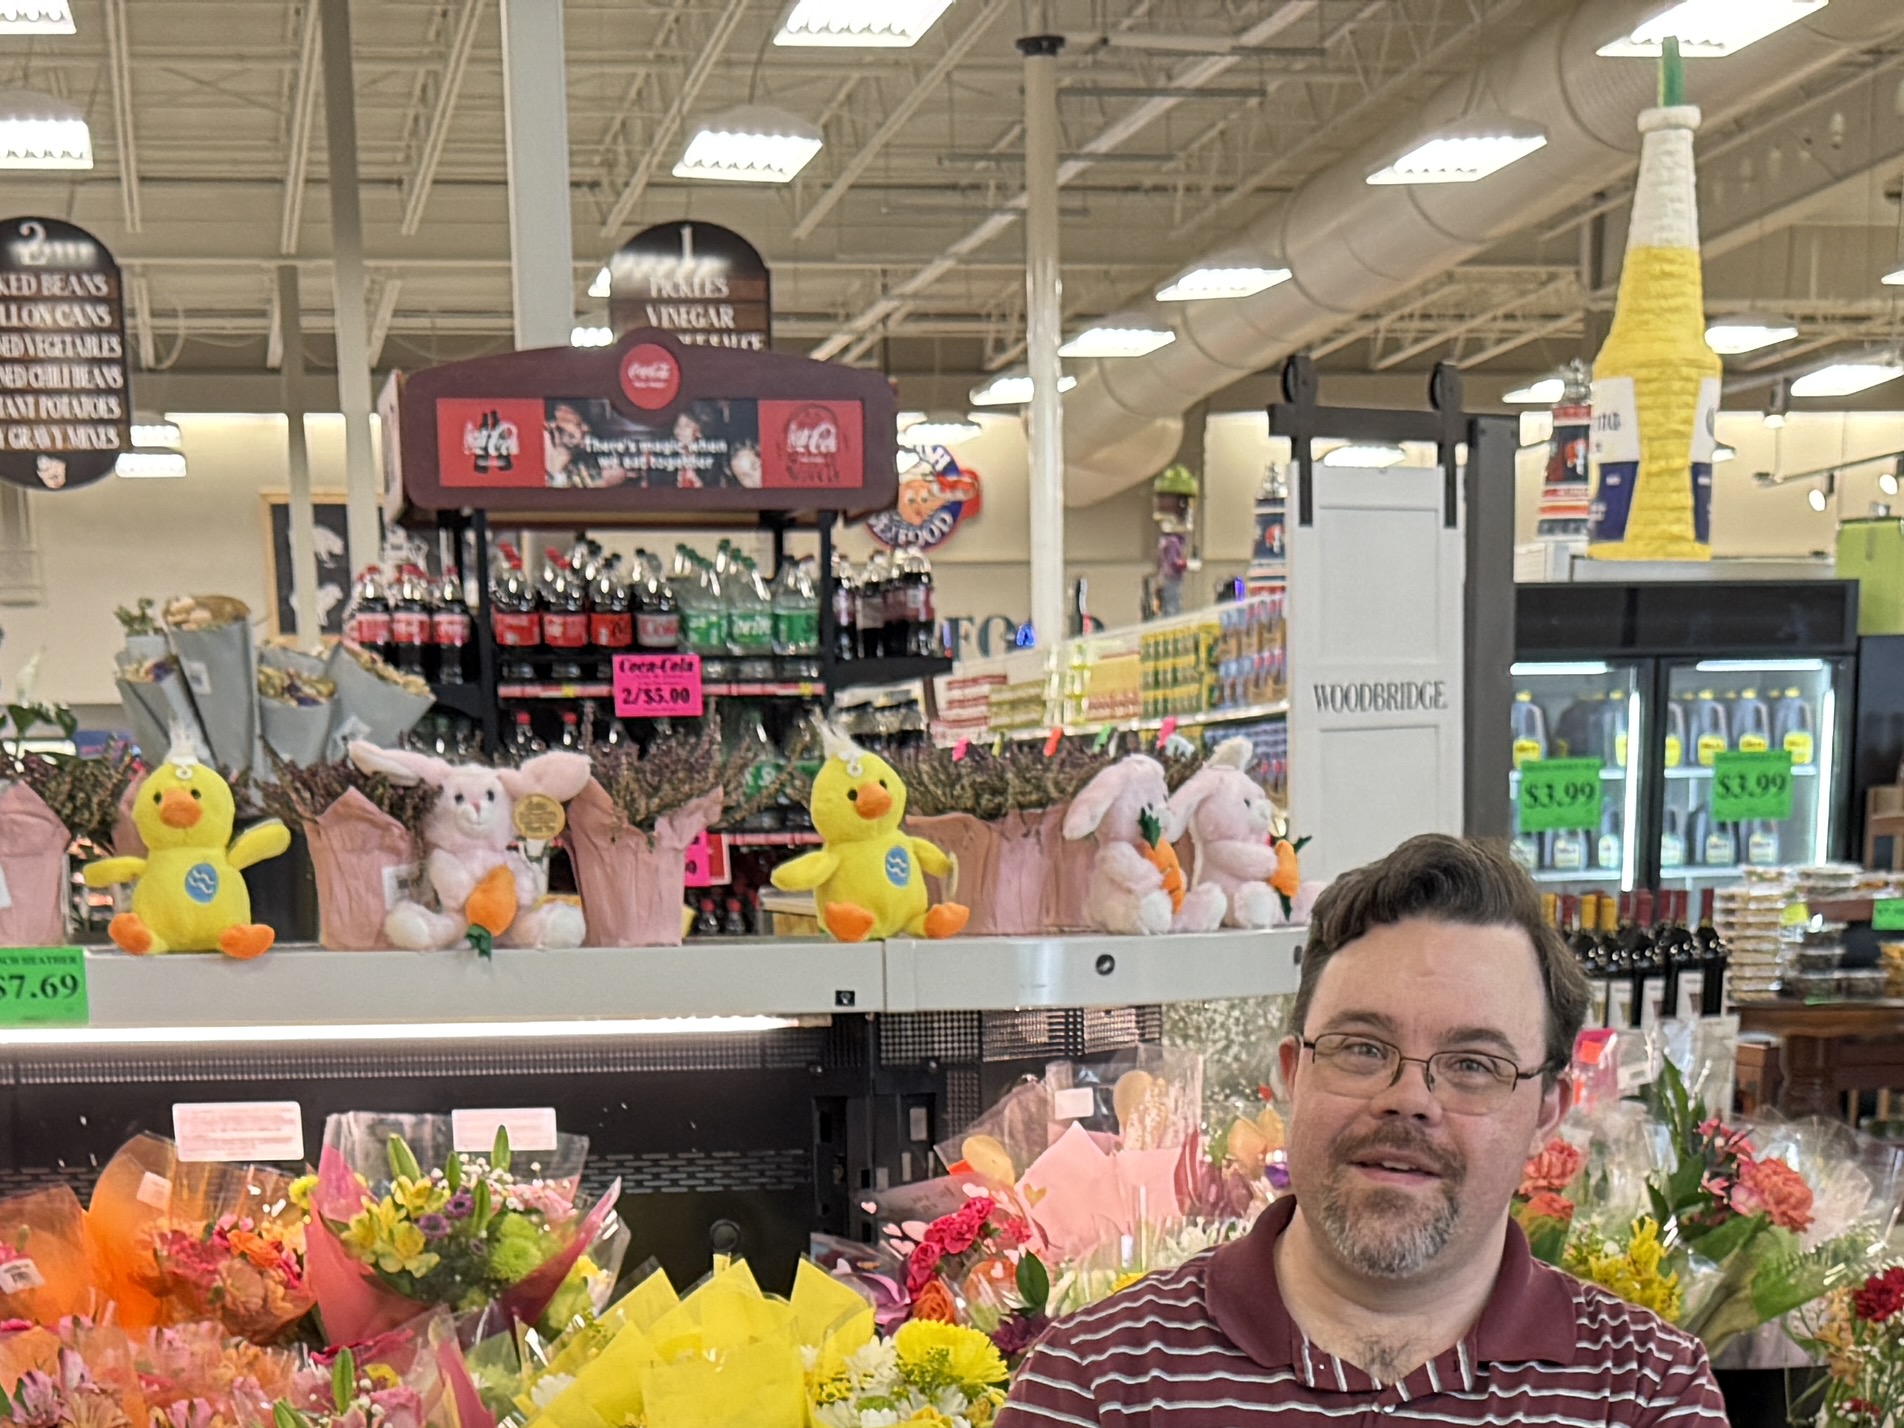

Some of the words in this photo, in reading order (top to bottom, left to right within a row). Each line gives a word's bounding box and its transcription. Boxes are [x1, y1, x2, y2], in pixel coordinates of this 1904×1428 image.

[40, 271, 109, 297] BEANS
[54, 303, 113, 328] CANS
[646, 304, 736, 329] VINEGAR
[619, 656, 695, 676] Coca-Cola
[1312, 679, 1448, 713] WOODBRIDGE
[1524, 782, 1596, 809] $3.99
[1716, 773, 1788, 799] $3.99
